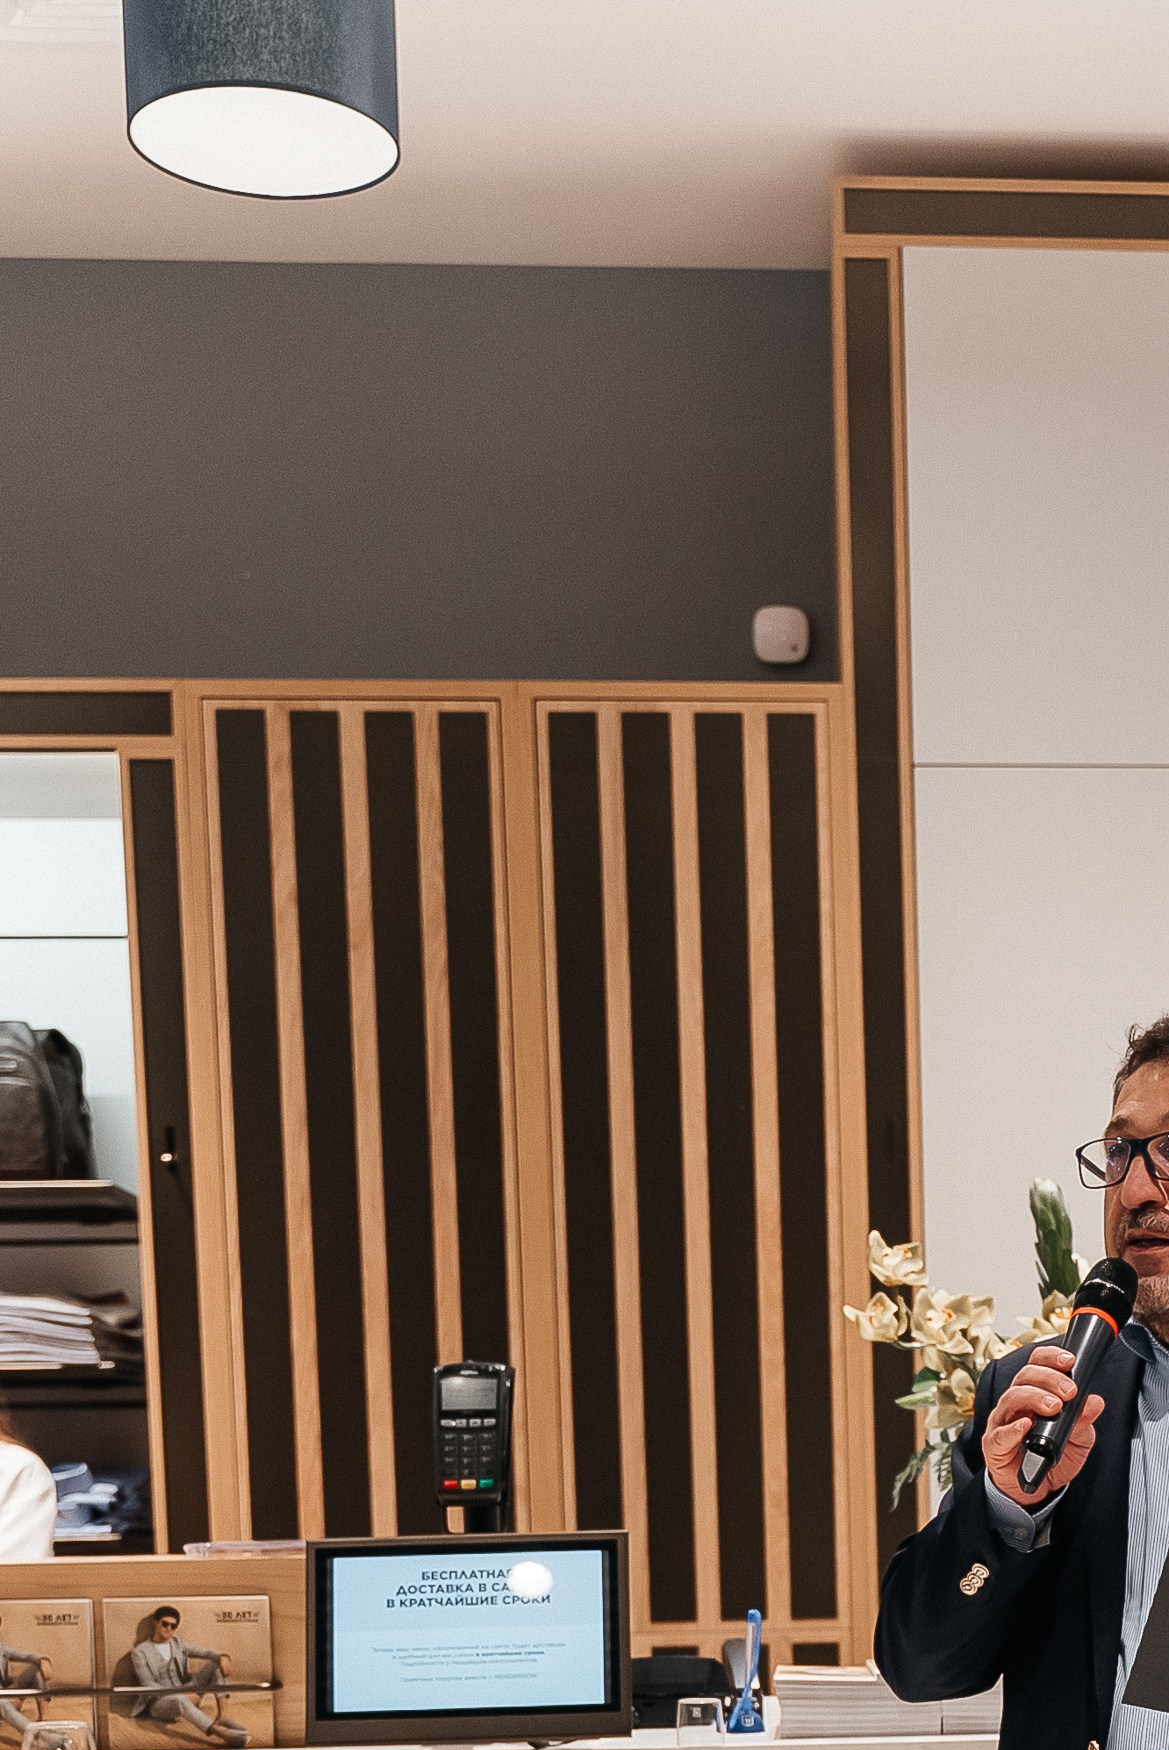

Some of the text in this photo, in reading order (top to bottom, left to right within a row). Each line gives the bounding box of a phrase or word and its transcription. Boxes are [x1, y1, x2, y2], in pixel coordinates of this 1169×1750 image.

[396, 1583, 475, 1597] ДОСТАВКА
[478, 1582, 488, 1593] В
[386, 1594, 551, 1609] В КРАТЧАЙШИЕ СРОКИ
